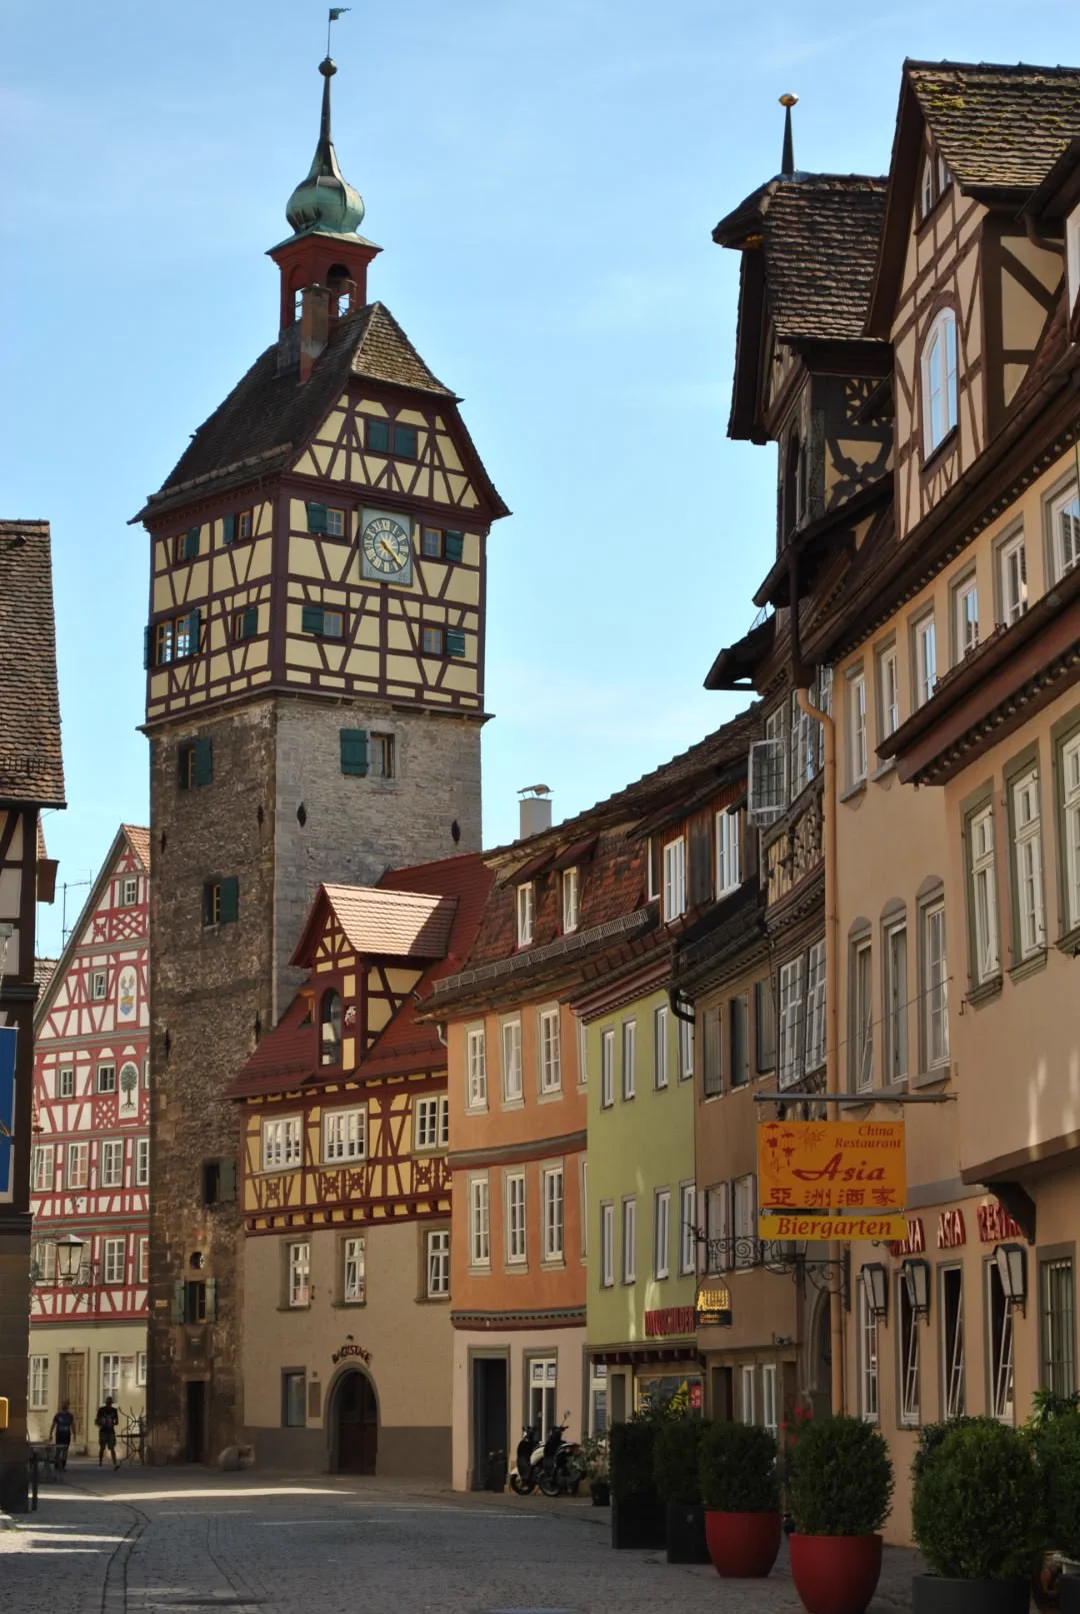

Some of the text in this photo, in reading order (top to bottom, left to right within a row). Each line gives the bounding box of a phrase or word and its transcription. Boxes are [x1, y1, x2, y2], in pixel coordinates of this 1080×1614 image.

[857, 1125, 894, 1137] China
[835, 1137, 902, 1149] Restaurant
[792, 1151, 886, 1182] Asia
[776, 1217, 892, 1239] Biergarten
[937, 1208, 967, 1249] ASIA
